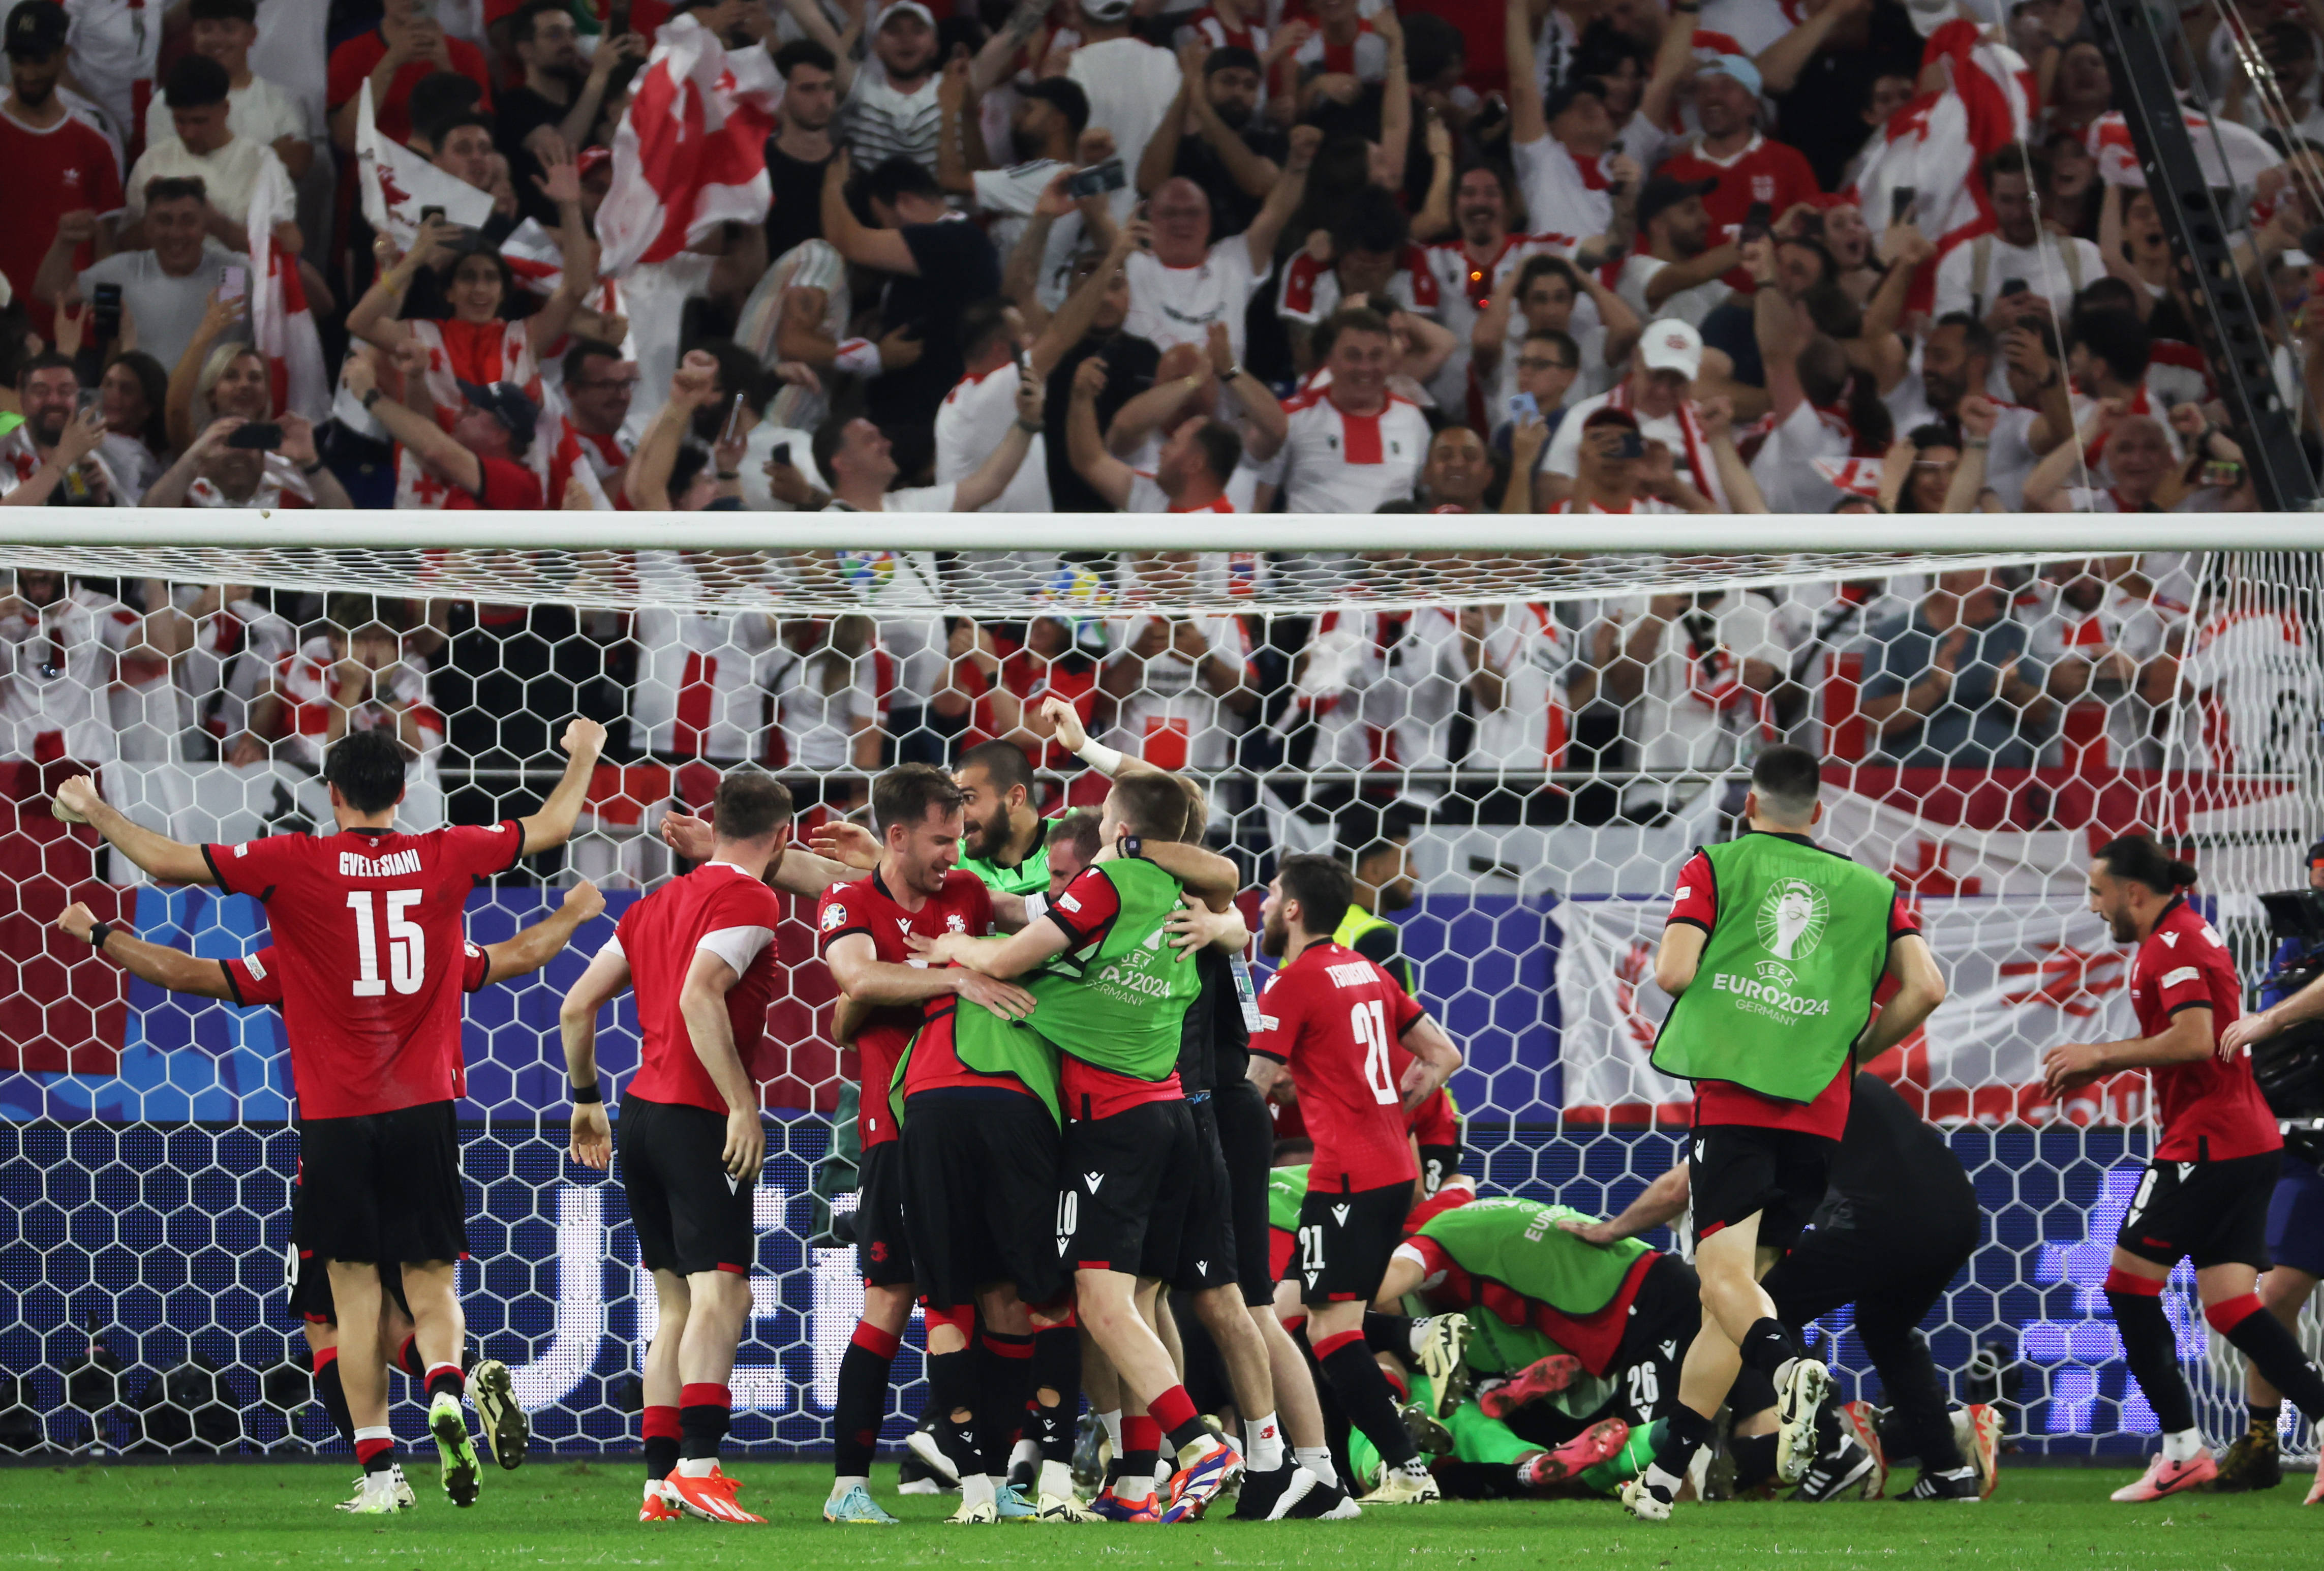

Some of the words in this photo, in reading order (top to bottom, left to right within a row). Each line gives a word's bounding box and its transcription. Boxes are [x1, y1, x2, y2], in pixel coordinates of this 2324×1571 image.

[339, 849, 422, 877] GVELESIANI
[346, 889, 425, 996] 15
[1712, 973, 1829, 1015] EURO2024
[1757, 965, 1794, 987] UEFA
[1735, 999, 1798, 1026] GERMANY
[1351, 1000, 1399, 1105] 21
[1299, 1225, 1326, 1270] 21
[1628, 1361, 1659, 1406] 26
